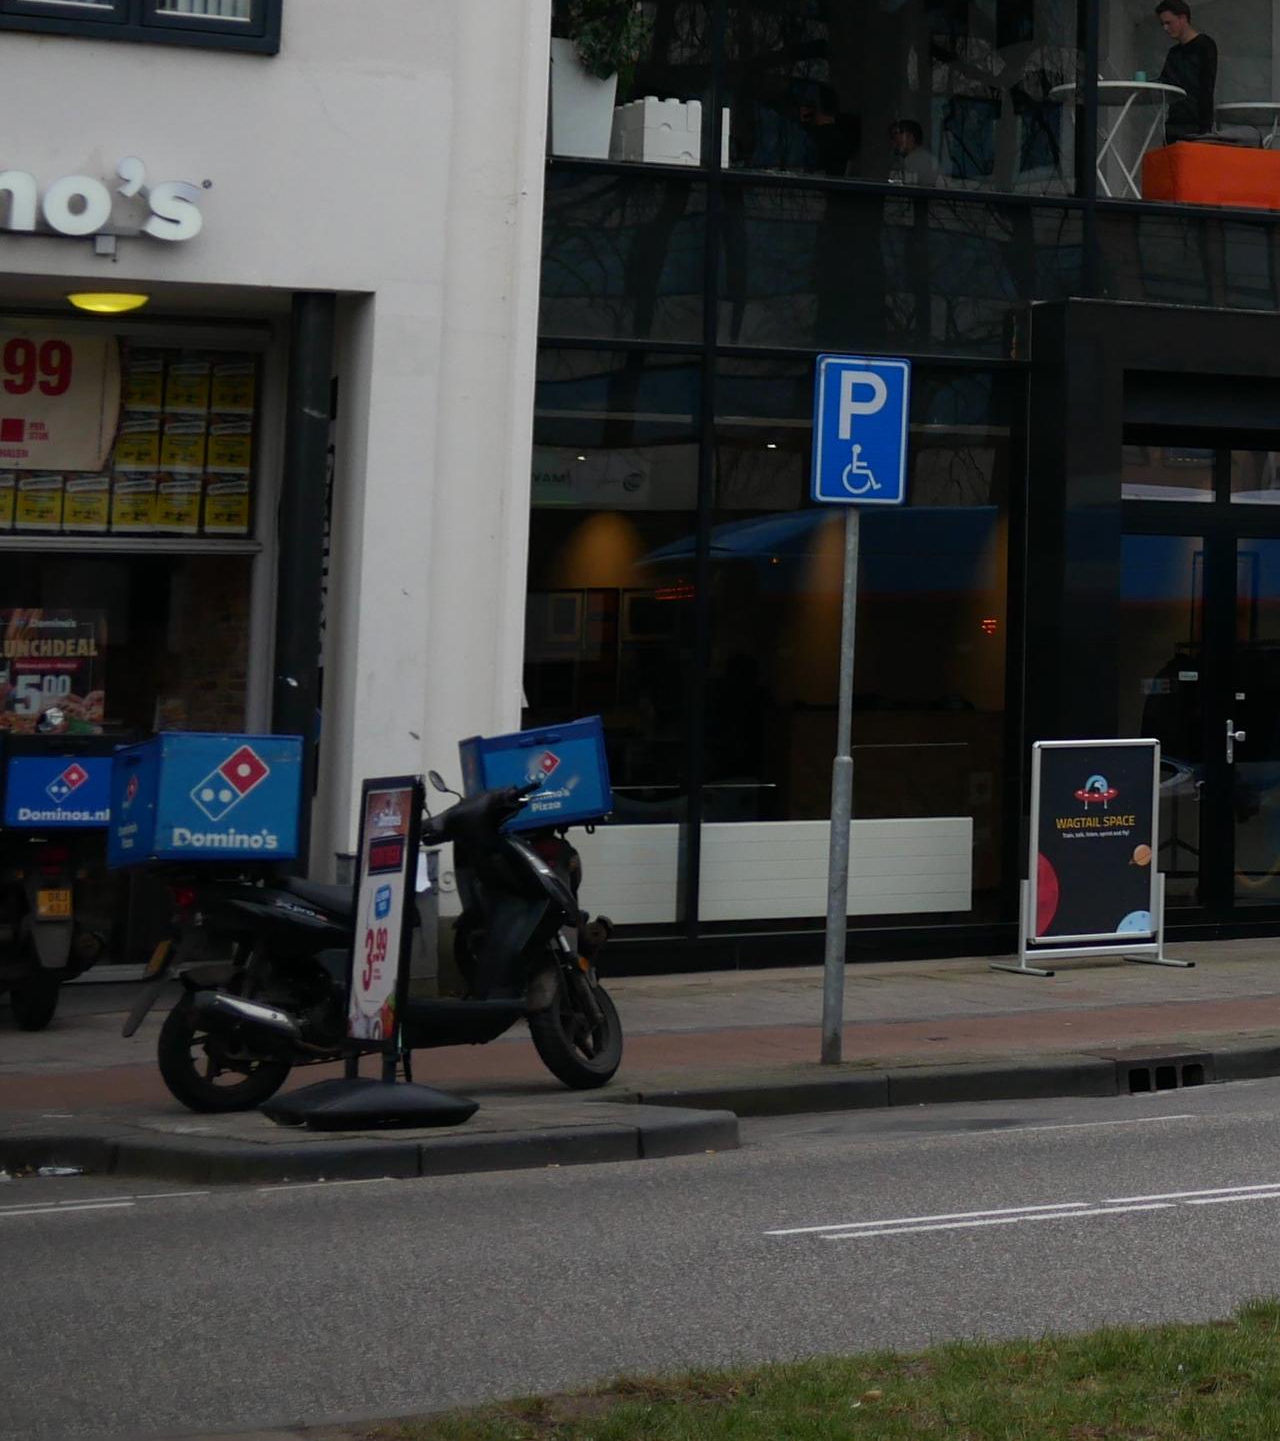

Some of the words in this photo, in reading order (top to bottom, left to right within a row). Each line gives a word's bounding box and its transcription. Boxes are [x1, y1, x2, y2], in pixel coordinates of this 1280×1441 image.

[838, 370, 887, 440] P
[0, 638, 98, 658] UNCHDEAL
[18, 807, 110, 822] Dominos.nl
[1056, 818, 1101, 829] WAGTAIL
[1103, 815, 1136, 827] SPACE
[172, 826, 278, 850] Domino's
